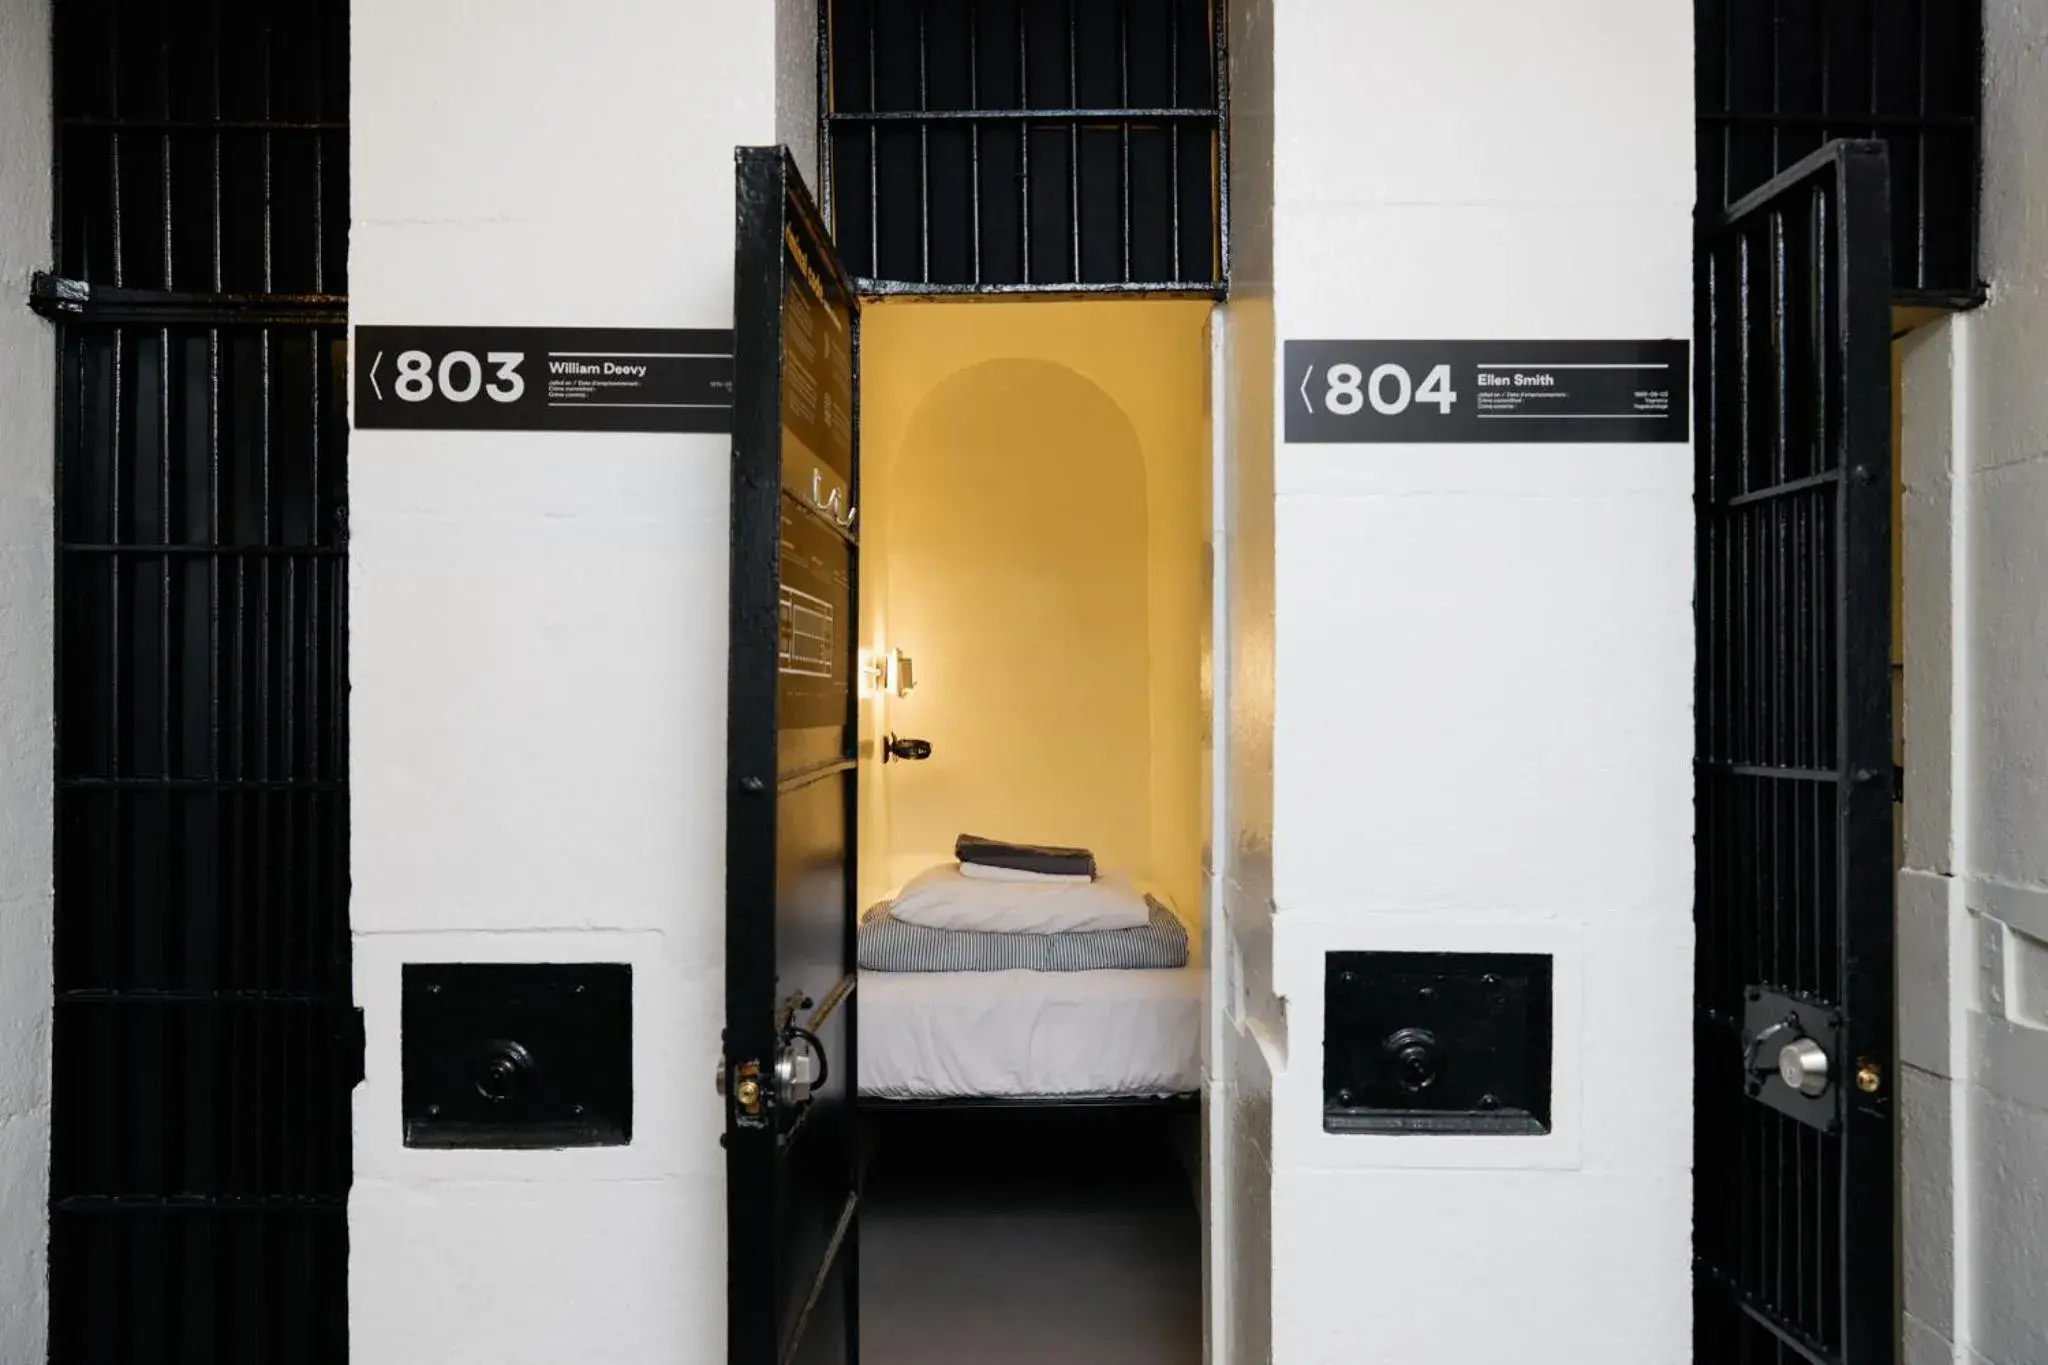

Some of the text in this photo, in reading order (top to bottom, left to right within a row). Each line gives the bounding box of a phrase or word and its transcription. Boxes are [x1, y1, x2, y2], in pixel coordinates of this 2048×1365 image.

[395, 350, 525, 403] 803
[549, 361, 601, 375] William
[1477, 373, 1555, 387] Ellen Smith
[1324, 363, 1457, 416] 804
